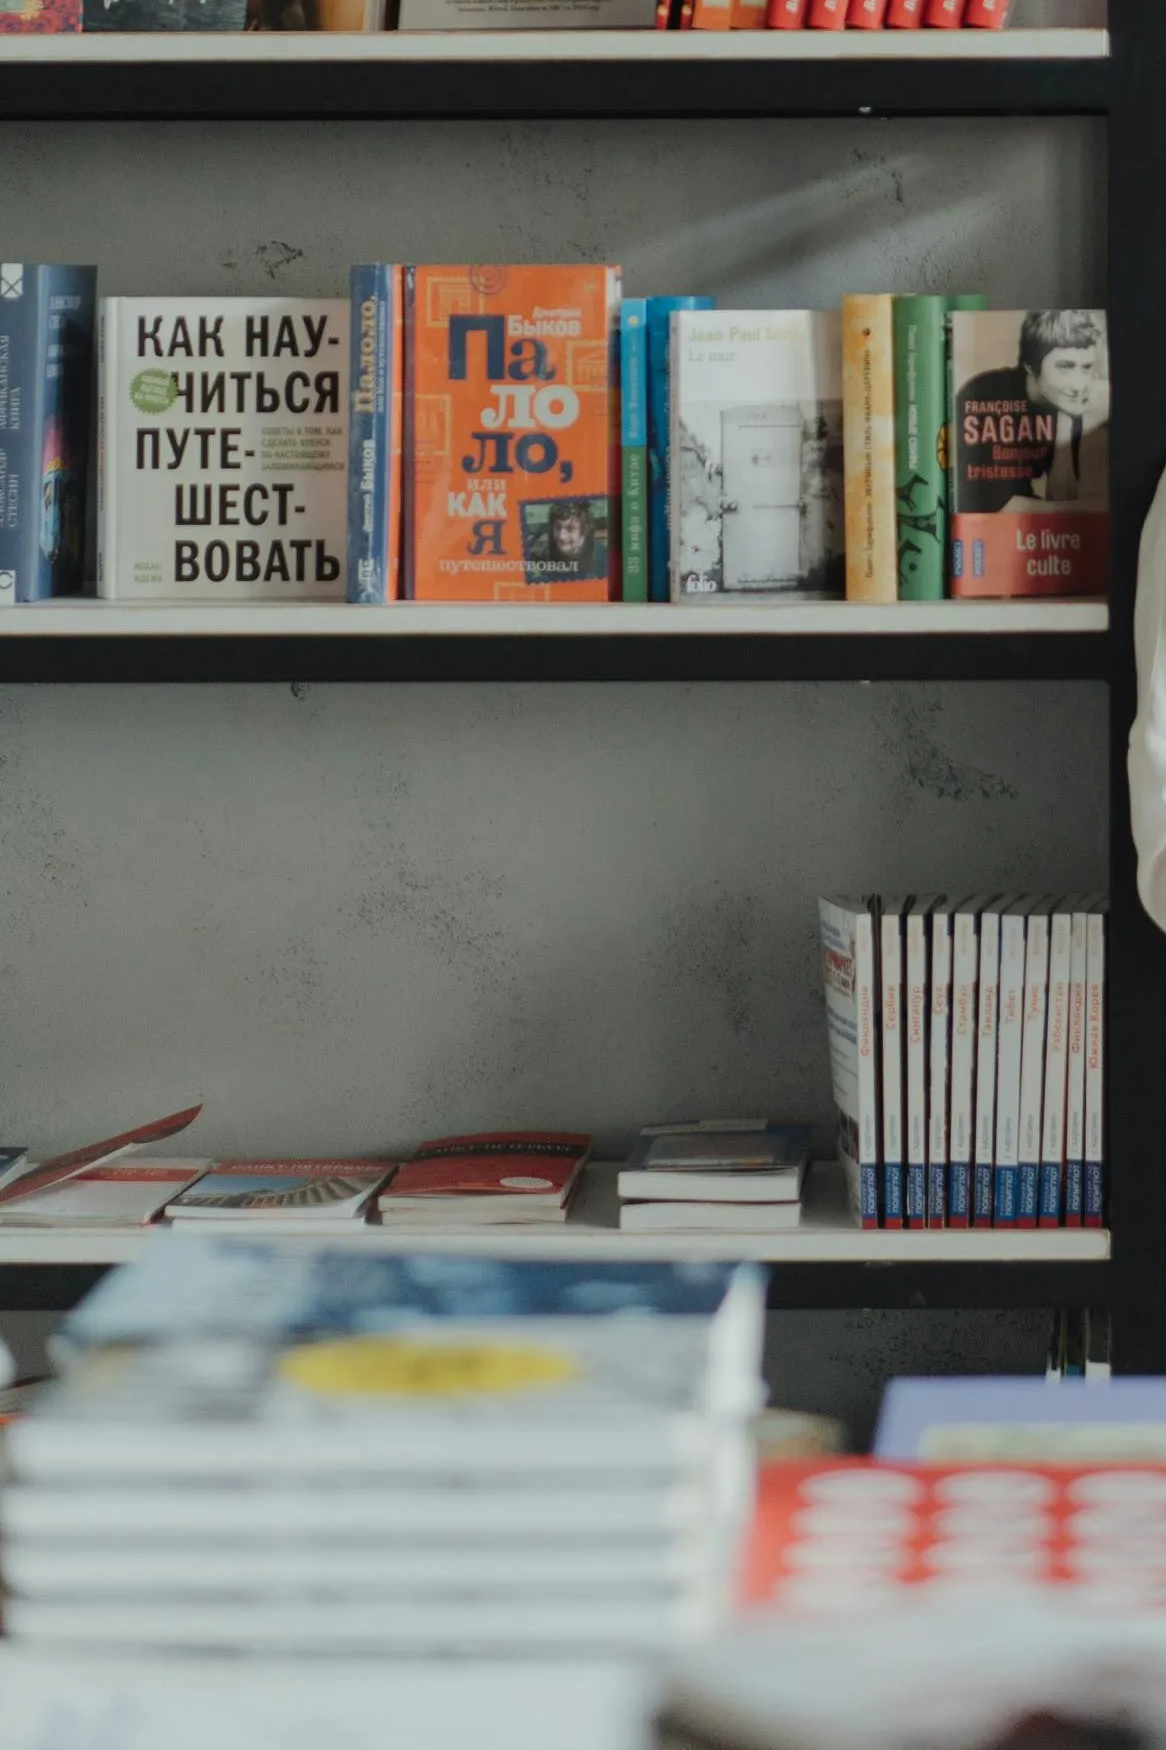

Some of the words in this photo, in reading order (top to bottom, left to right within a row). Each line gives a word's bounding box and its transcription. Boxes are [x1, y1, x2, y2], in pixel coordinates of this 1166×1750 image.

[137, 315, 224, 358] КАК
[244, 315, 339, 358] НАУ-
[449, 315, 556, 381] Па
[688, 348, 705, 362] Le
[171, 371, 340, 413] ЧИТЬСЯ
[480, 385, 580, 429] ло
[964, 400, 1028, 415] FRANÇOISE
[964, 415, 1053, 444] SAGAN
[136, 428, 255, 470] ПУТЕ-
[462, 432, 573, 483] ло,
[467, 479, 506, 491] или
[627, 453, 639, 496] Китае
[175, 483, 305, 526] ШЕСТ-
[448, 493, 507, 517] КАК
[1016, 529, 1036, 549] Le
[1041, 528, 1081, 549] livre
[174, 539, 340, 582] ВОВАТЬ
[439, 558, 579, 573] путешествовал
[1026, 554, 1072, 576] culte
[686, 575, 716, 593] folio
[910, 986, 921, 1044] Сингапур
[933, 985, 944, 1015] Сеул
